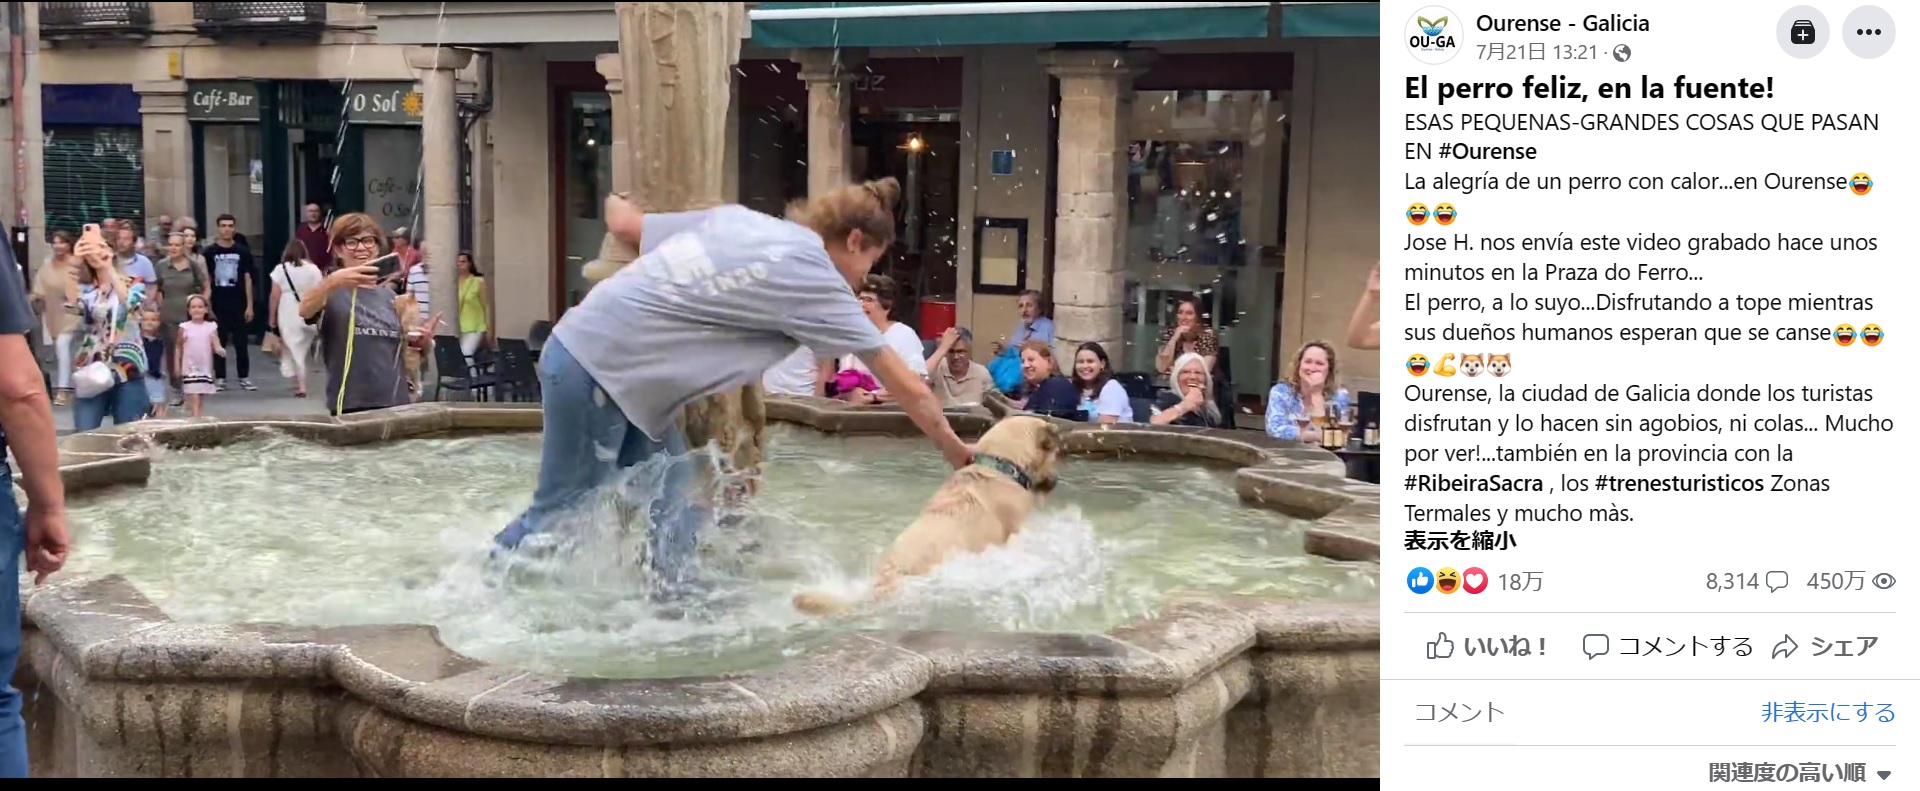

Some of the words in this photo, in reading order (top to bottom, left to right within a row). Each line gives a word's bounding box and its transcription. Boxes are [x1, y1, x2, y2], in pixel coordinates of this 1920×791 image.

[193, 89, 253, 113] Café-Bar
[354, 93, 366, 112] O
[372, 90, 400, 113] Sol
